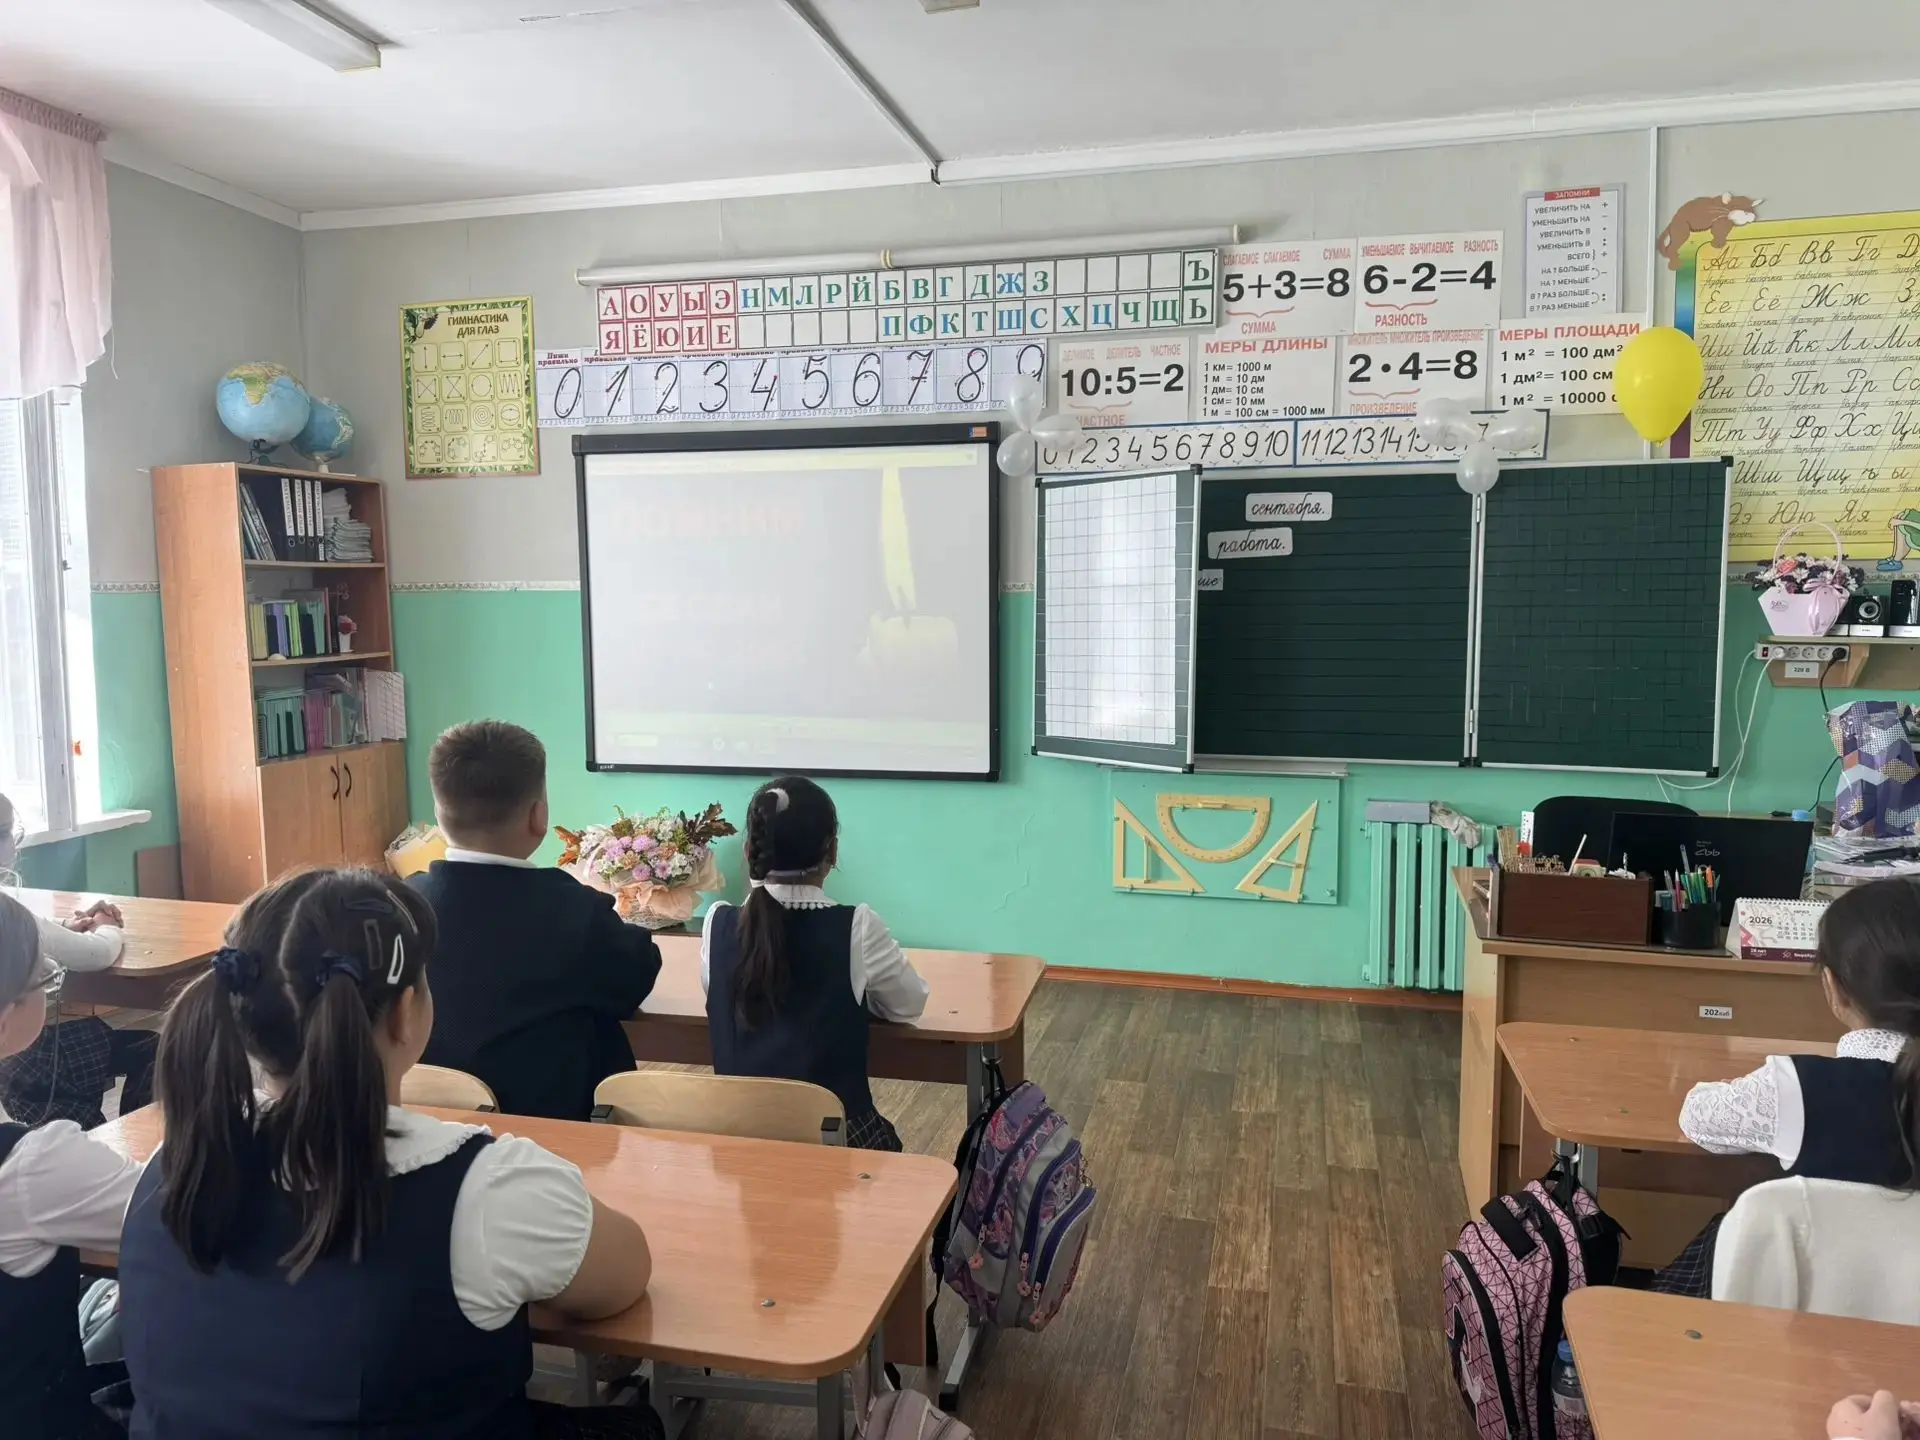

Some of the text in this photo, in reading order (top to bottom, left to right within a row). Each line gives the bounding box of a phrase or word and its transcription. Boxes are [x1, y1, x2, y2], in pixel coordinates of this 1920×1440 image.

[1555, 189, 1591, 199] ЗАПОМНИ
[1534, 205, 1579, 214] УВЕЛИЧИТЬ
[1532, 217, 1579, 227] УМЕНЬШИТЬ
[1539, 230, 1584, 238] УВЕЛИЧИТЬ
[1410, 241, 1454, 255] ВЫЧИТАЕМОЕ
[1463, 239, 1499, 252] РАЗНОСТЬ
[1537, 242, 1584, 251] УМЕНЬШИТЬ
[1750, 242, 1791, 268] Бб
[1799, 240, 1835, 265] Вв
[1848, 235, 1881, 262] Гг
[1323, 247, 1351, 261] СУММА
[1567, 252, 1591, 261] ВСЕГО
[1541, 265, 1590, 275] НА БОЛЬШЕ
[603, 259, 1210, 316] А О У Ы Э Н М Л Р Й Б В Г Д Ж З Ъ
[1557, 277, 1590, 285] МЕНЬШЕ
[1542, 289, 1590, 299] РАЗ БОЛЬШЕ
[1705, 290, 1732, 314] Ее
[1801, 282, 1871, 309] Жж
[1557, 301, 1590, 310] МЕНЬШЕ
[447, 313, 509, 326] ГИМНАСТИКА
[605, 298, 1207, 349] Я Ё Ю И Е П Ф К Т Ш С Х Ц Ч Щ Ь
[1375, 313, 1428, 326] РАЗНОСТЬ
[456, 325, 500, 339] ДЛЯ ГЛАЗ
[1241, 321, 1276, 334] СУММА
[1500, 323, 1640, 341] МЕРЫ ПЛОЩАДИ
[1205, 338, 1328, 354] МЕРЫ ДЛИНЫ
[1743, 328, 1778, 356] Йй
[1785, 328, 1820, 353] Кк
[1501, 351, 1507, 361] 1
[1561, 347, 1588, 359] 100
[1237, 362, 1260, 371] 1000
[554, 367, 582, 418] 0
[605, 365, 629, 416] 1
[654, 362, 679, 414] 2
[699, 360, 728, 412] 3
[750, 358, 778, 411] 4
[801, 355, 829, 409] 5
[853, 352, 881, 407] 6
[907, 350, 934, 405] 7
[956, 347, 988, 403] 8
[1236, 374, 1248, 383] 10
[1250, 375, 1265, 384] дм
[1500, 373, 1507, 383] 1
[1560, 369, 1588, 381] 100
[1592, 371, 1613, 380] см
[1236, 385, 1248, 394] 10
[1250, 386, 1264, 394] см
[1698, 374, 1735, 400] Нн
[1746, 373, 1774, 398] Оо
[1784, 370, 1829, 396] Пп
[1841, 368, 1878, 405] Рр
[1235, 397, 1248, 406] 10
[1250, 397, 1265, 406] мм
[1500, 395, 1506, 406] 1
[1559, 391, 1606, 404] 10000
[1235, 408, 1253, 417] 100
[1256, 408, 1269, 417] см
[1283, 406, 1307, 416] 1000
[1310, 406, 1325, 415] мм
[1350, 402, 1417, 415] ПРОИЗВЕДЕНИЕ
[1076, 414, 1126, 427] ЧАСТНОЕ
[1082, 438, 1098, 463] 2
[1105, 436, 1120, 463] 3
[1127, 435, 1143, 462] 4
[1151, 435, 1168, 461] 5
[1175, 434, 1192, 461] 6
[1198, 433, 1214, 460] 7
[1219, 431, 1237, 458] 8
[1242, 430, 1259, 458] 9
[1264, 430, 1289, 457] 10
[1301, 426, 1402, 457] 11 12 13 14
[1749, 916, 1773, 925] 2026
